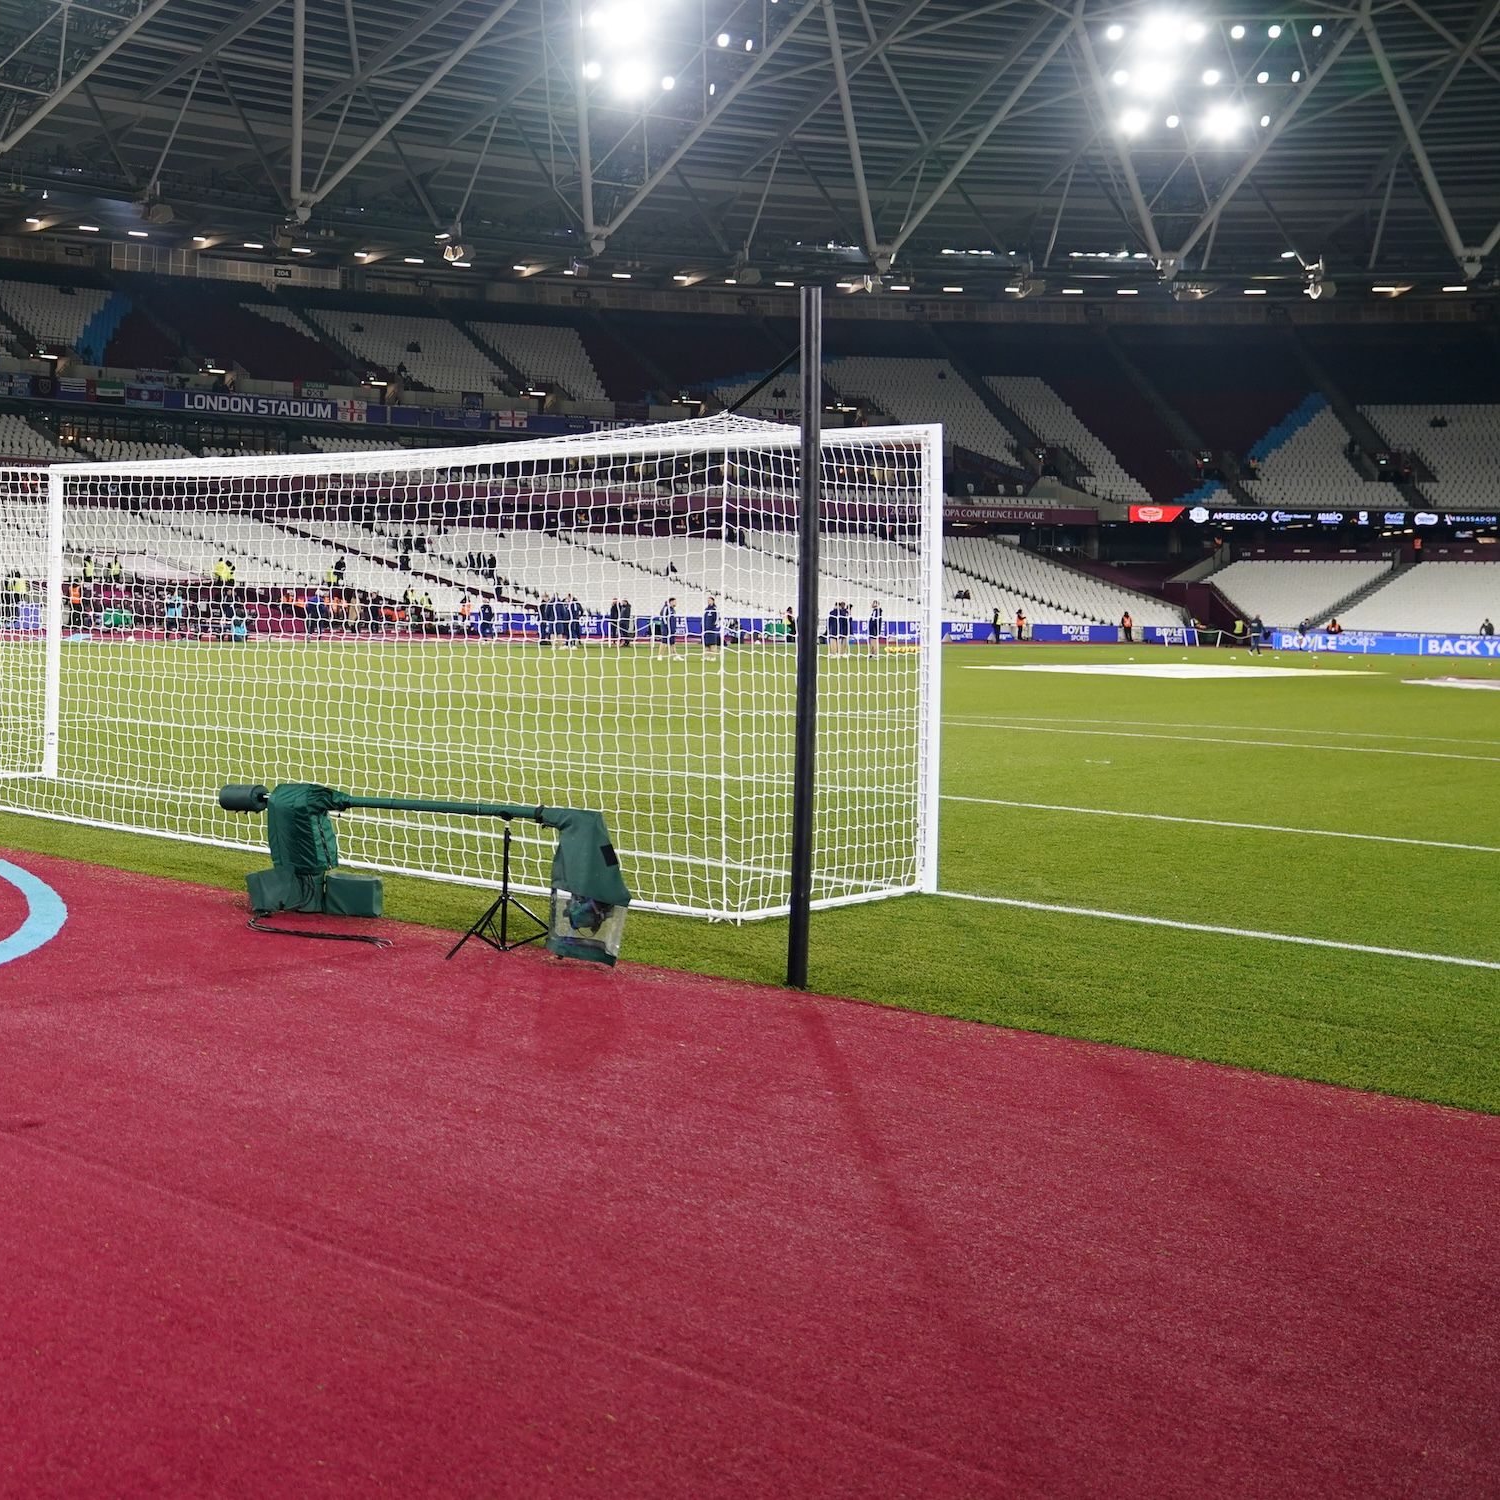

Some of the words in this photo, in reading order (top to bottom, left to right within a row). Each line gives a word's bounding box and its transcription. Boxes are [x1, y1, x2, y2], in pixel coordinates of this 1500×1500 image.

[185, 393, 253, 413] LONDON
[257, 399, 331, 418] STADIUM
[961, 509, 1012, 519] CONFERENCE
[1013, 511, 1045, 520] LEAGUE
[1212, 512, 1258, 521] AMERESCO
[951, 623, 974, 632] BOYLE
[1062, 626, 1089, 635] BOYLE
[1156, 628, 1183, 637] BOYLE
[1281, 634, 1337, 650] BOYLE
[1338, 637, 1377, 647] SPORTS
[1428, 639, 1481, 656] BACK
